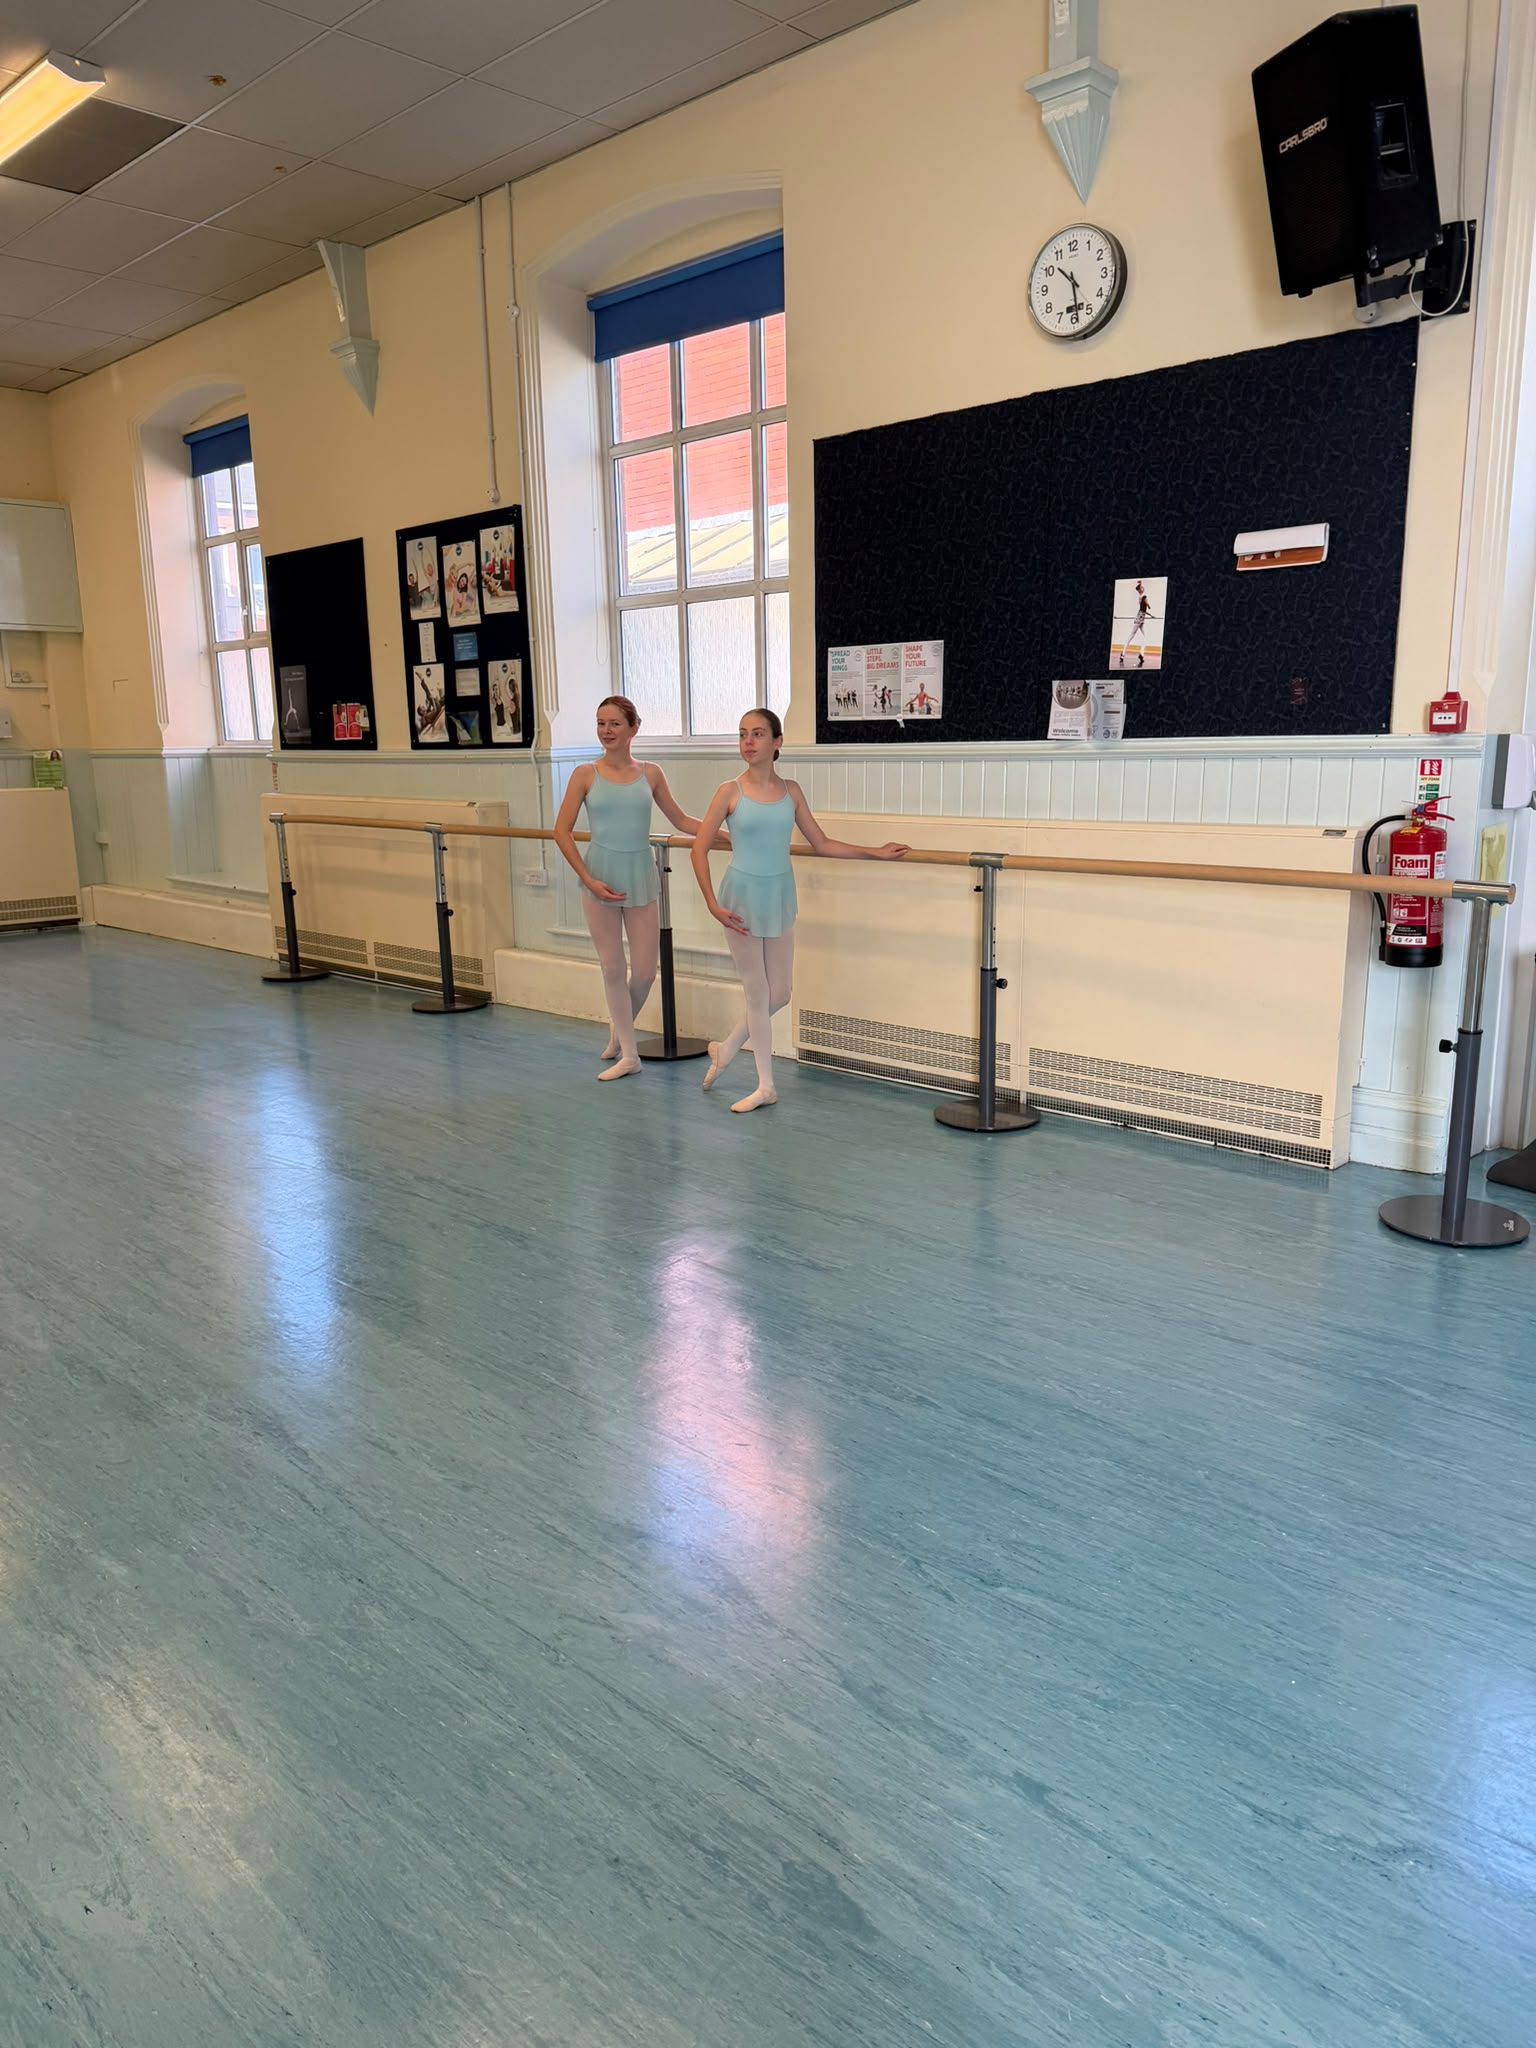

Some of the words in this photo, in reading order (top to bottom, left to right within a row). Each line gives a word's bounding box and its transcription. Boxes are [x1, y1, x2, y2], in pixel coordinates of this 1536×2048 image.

[1279, 117, 1327, 154] CARLSBRO
[1068, 240, 1079, 253] 12
[1086, 240, 1091, 251] 1
[1055, 249, 1063, 261] 11
[1096, 249, 1104, 261] 2
[1044, 265, 1055, 277] 10
[1100, 267, 1108, 279] 3
[1041, 285, 1049, 296] 9
[1096, 287, 1104, 299] 4
[1045, 302, 1053, 314] 8
[1085, 303, 1093, 315] 5
[1056, 312, 1064, 324] 7
[1070, 312, 1079, 324] 6
[866, 648, 882, 656] LITTLE
[876, 661, 899, 669] DREAMS
[1394, 855, 1428, 869] Foam
